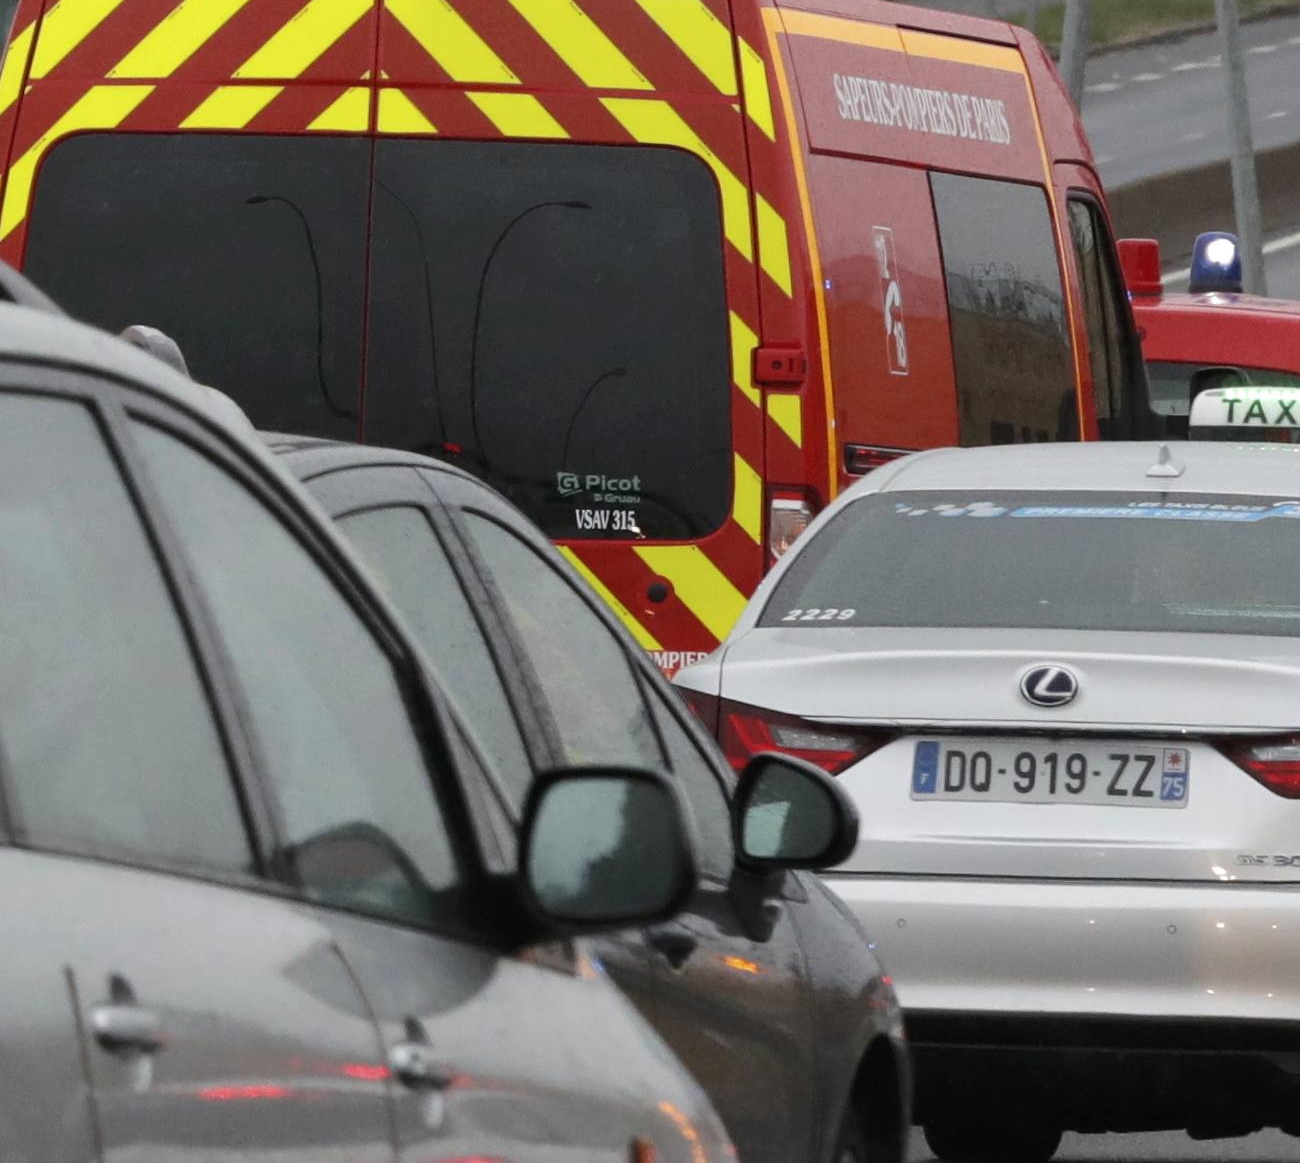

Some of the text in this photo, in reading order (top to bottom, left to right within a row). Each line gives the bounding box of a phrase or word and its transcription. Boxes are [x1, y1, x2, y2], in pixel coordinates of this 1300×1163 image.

[585, 474, 641, 491] Picot
[604, 493, 640, 503] Gruau
[575, 509, 636, 531] VSAV 315
[781, 608, 856, 621] 2229
[944, 740, 1157, 798] DQ-919-ZZ
[1162, 777, 1185, 797] 75
